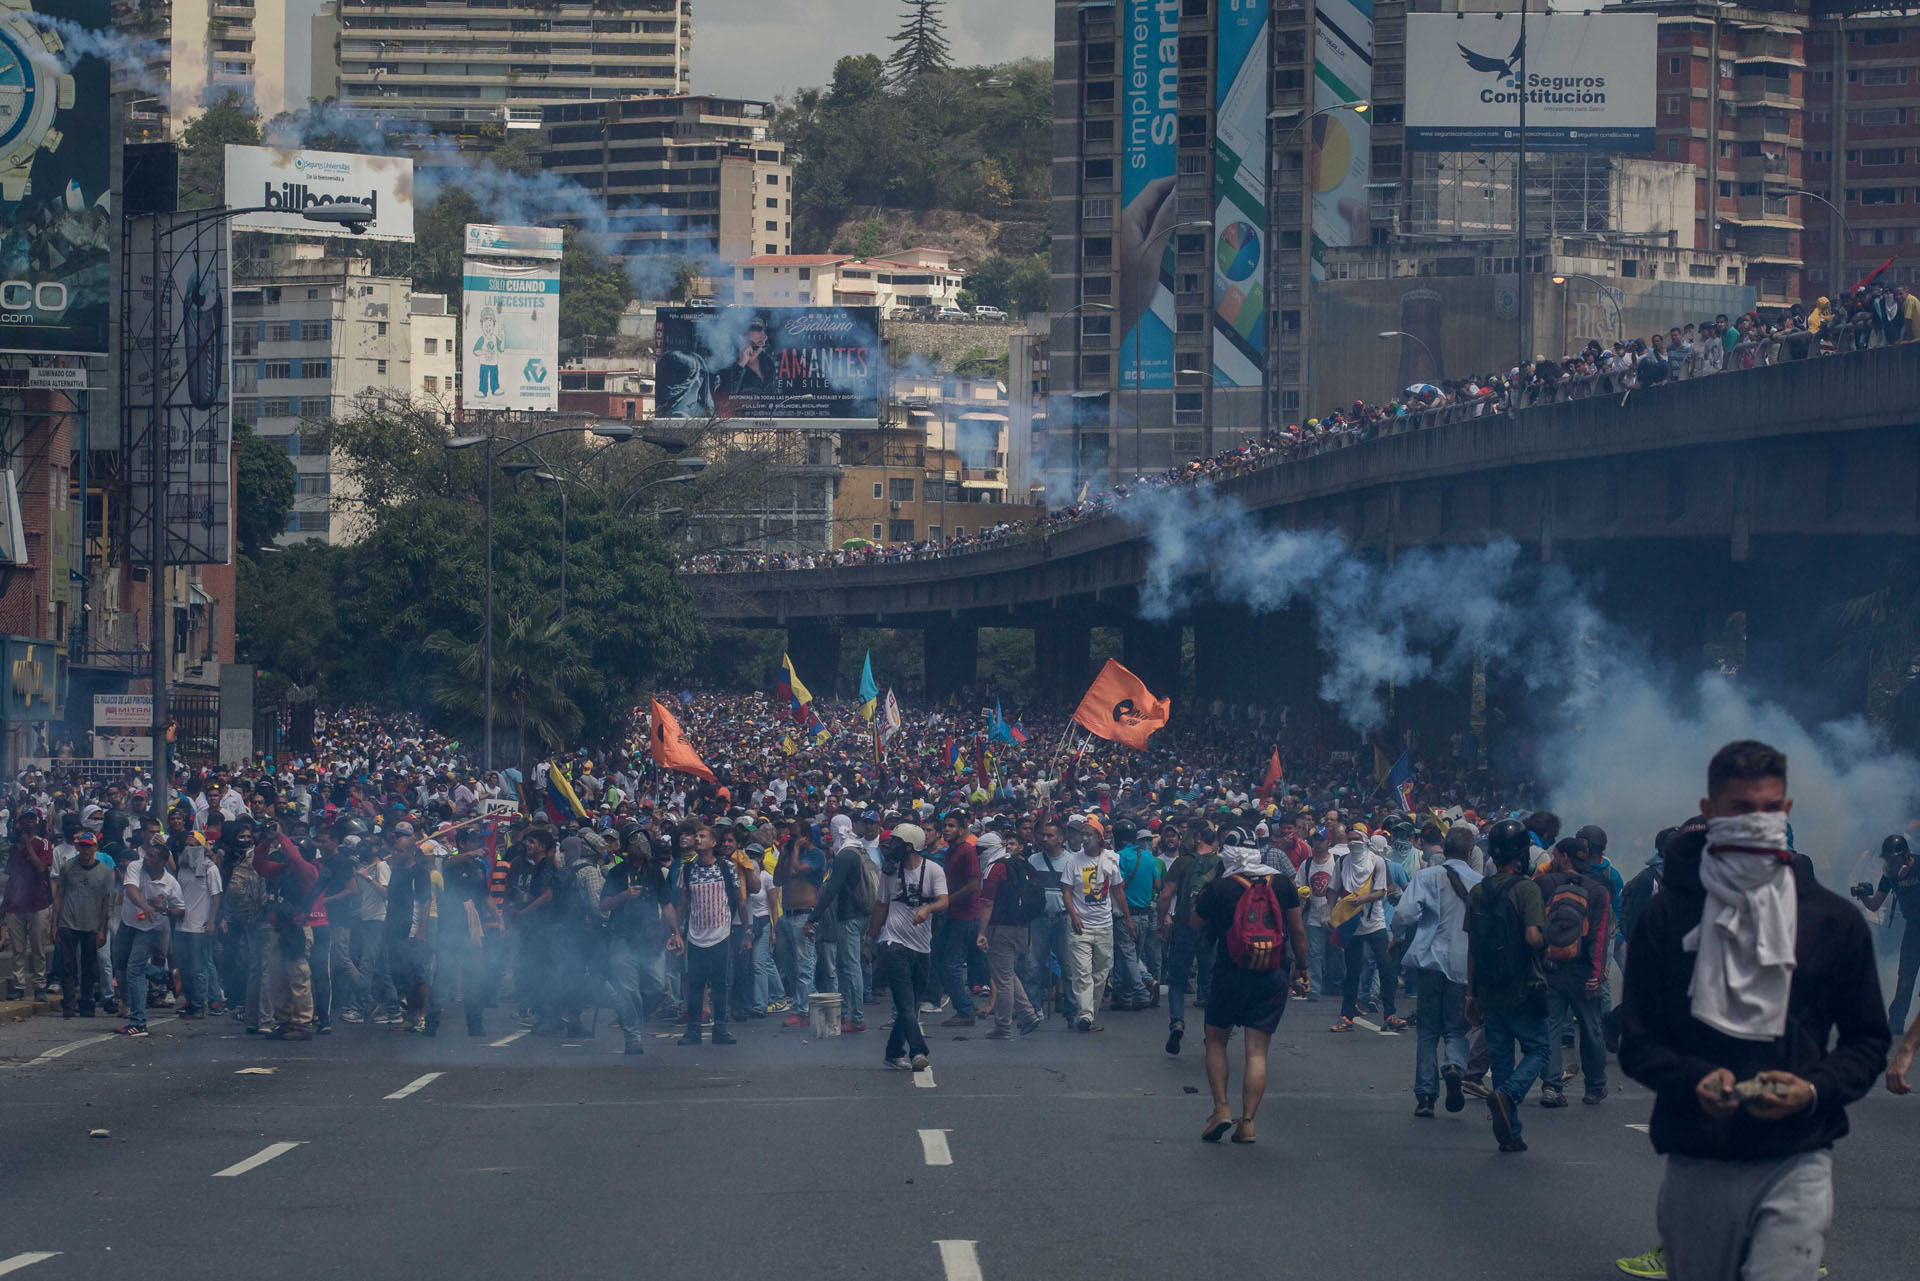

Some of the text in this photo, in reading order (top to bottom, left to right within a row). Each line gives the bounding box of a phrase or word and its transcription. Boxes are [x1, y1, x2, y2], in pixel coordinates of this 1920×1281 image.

[1151, 0, 1180, 145] Smart
[1528, 73, 1605, 90] Seguros
[1480, 88, 1606, 104] Constitución
[506, 280, 546, 292] CUANDO
[484, 296, 545, 308] LA NECESITES
[778, 346, 868, 378] AMANTES
[778, 379, 792, 388] EN
[94, 696, 100, 704] EL
[101, 696, 118, 704] PALACIO
[118, 696, 124, 704] DE
[124, 696, 133, 704] LAS
